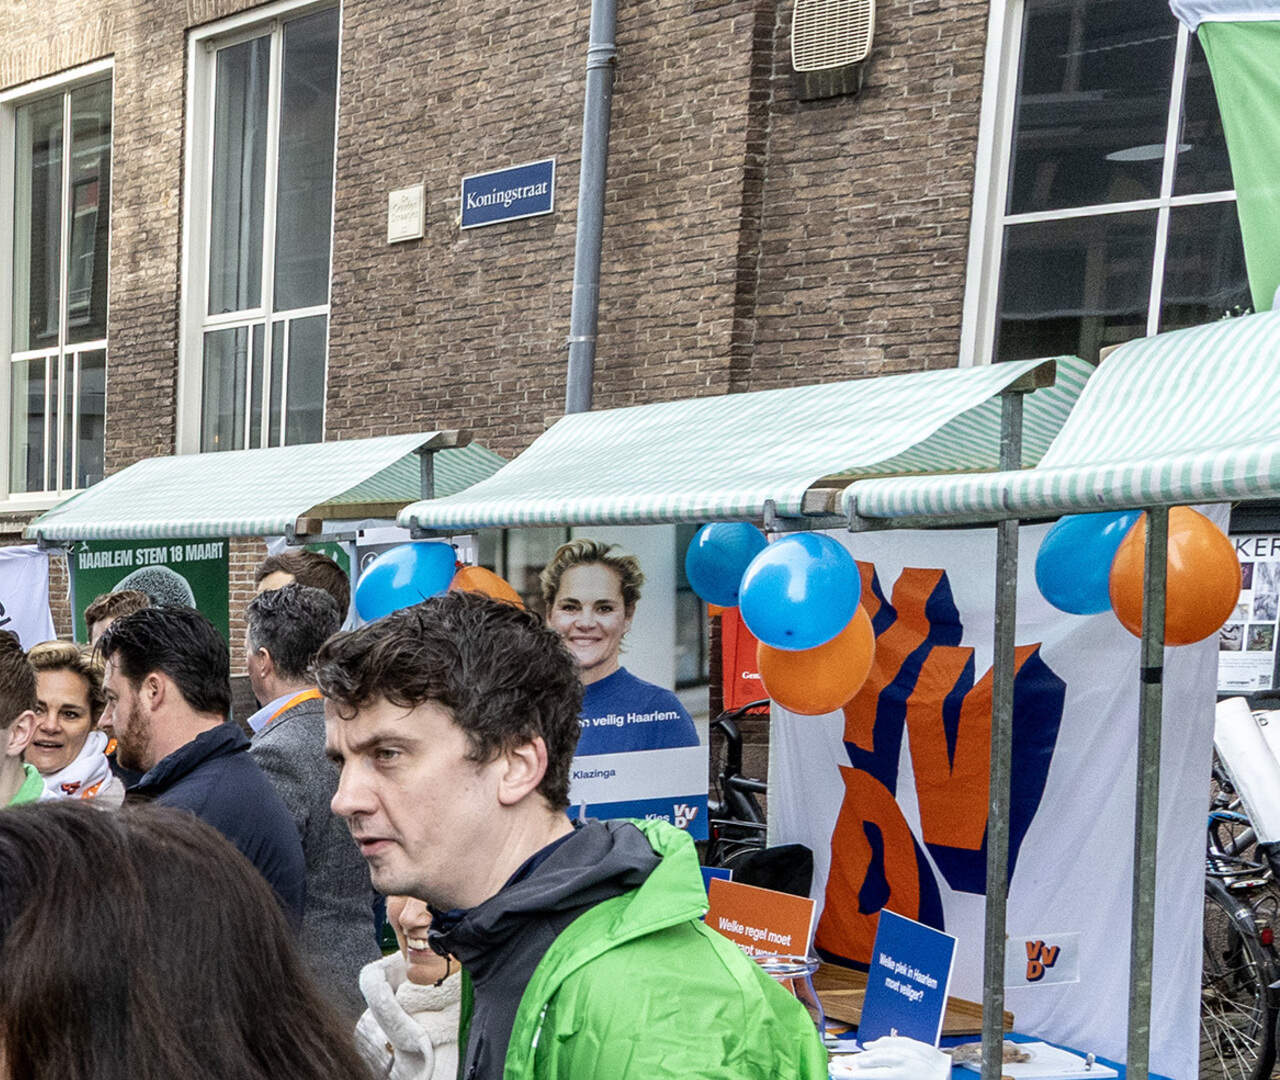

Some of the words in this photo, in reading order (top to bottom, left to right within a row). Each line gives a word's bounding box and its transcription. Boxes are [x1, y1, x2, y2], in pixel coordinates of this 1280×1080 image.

[466, 181, 548, 208] Koningstraat
[78, 549, 133, 570] HAARLEM
[135, 546, 168, 565] STEM
[169, 545, 183, 562] 18
[185, 541, 225, 561] MAART
[593, 713, 625, 727] veilig
[627, 710, 681, 724] Haarlem.
[572, 768, 616, 780] Klazinga
[719, 916, 744, 935] Welke
[744, 925, 768, 942] regel
[768, 931, 792, 947] moet
[1025, 940, 1060, 982] VVD
[913, 967, 938, 990] Haarlem
